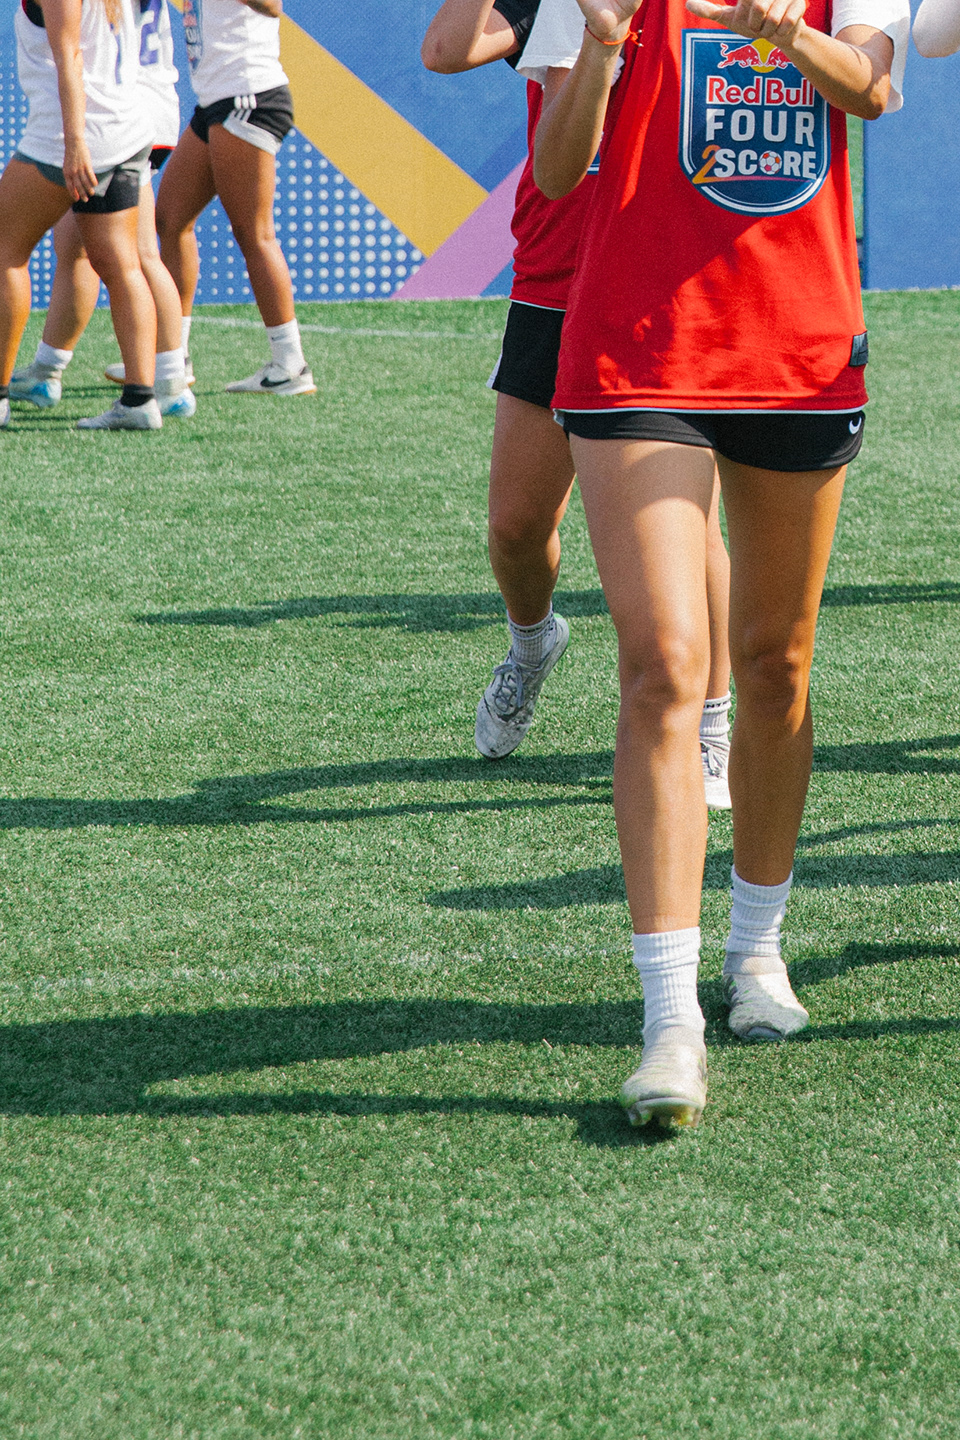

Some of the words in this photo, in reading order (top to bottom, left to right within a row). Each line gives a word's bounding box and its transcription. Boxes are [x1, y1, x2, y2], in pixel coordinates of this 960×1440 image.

[706, 75, 763, 105] Red
[764, 77, 815, 107] Bull
[706, 109, 815, 148] FOUR
